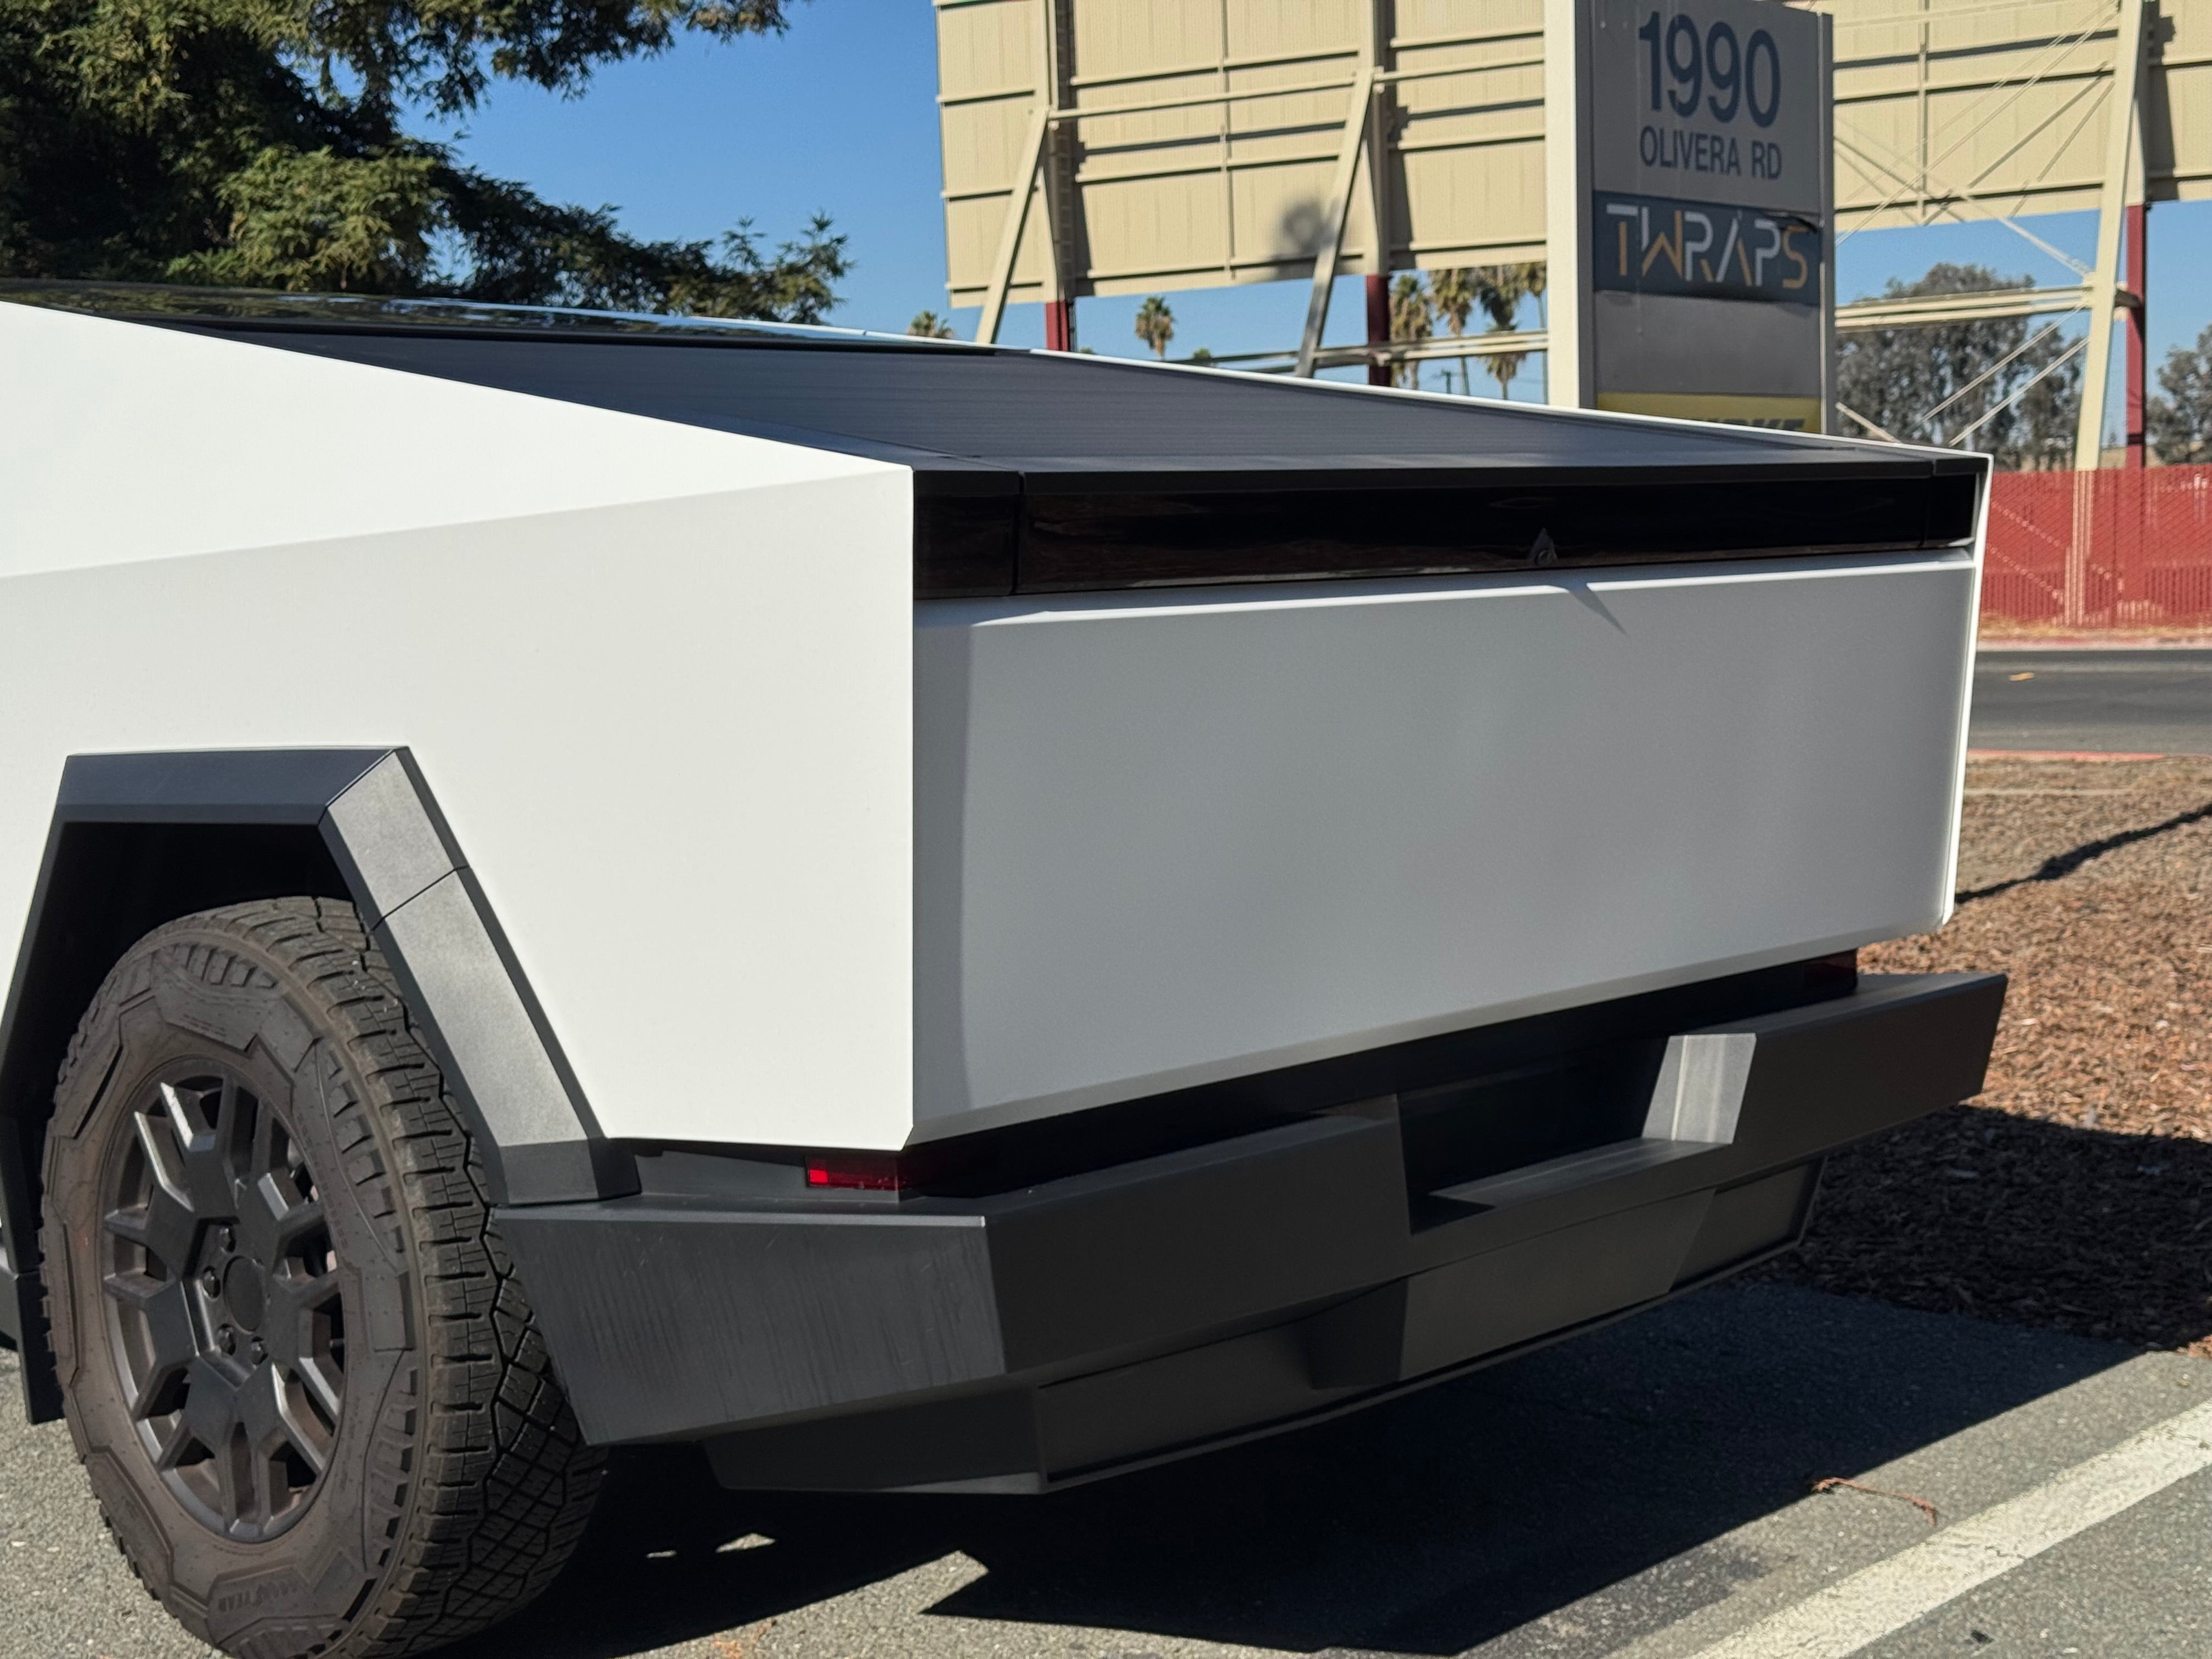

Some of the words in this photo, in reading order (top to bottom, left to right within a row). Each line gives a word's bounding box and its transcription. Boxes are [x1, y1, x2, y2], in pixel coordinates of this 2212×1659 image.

[1639, 10, 1780, 128] 1990
[1639, 125, 1741, 177] OLIVERA
[1751, 140, 1782, 180] RD
